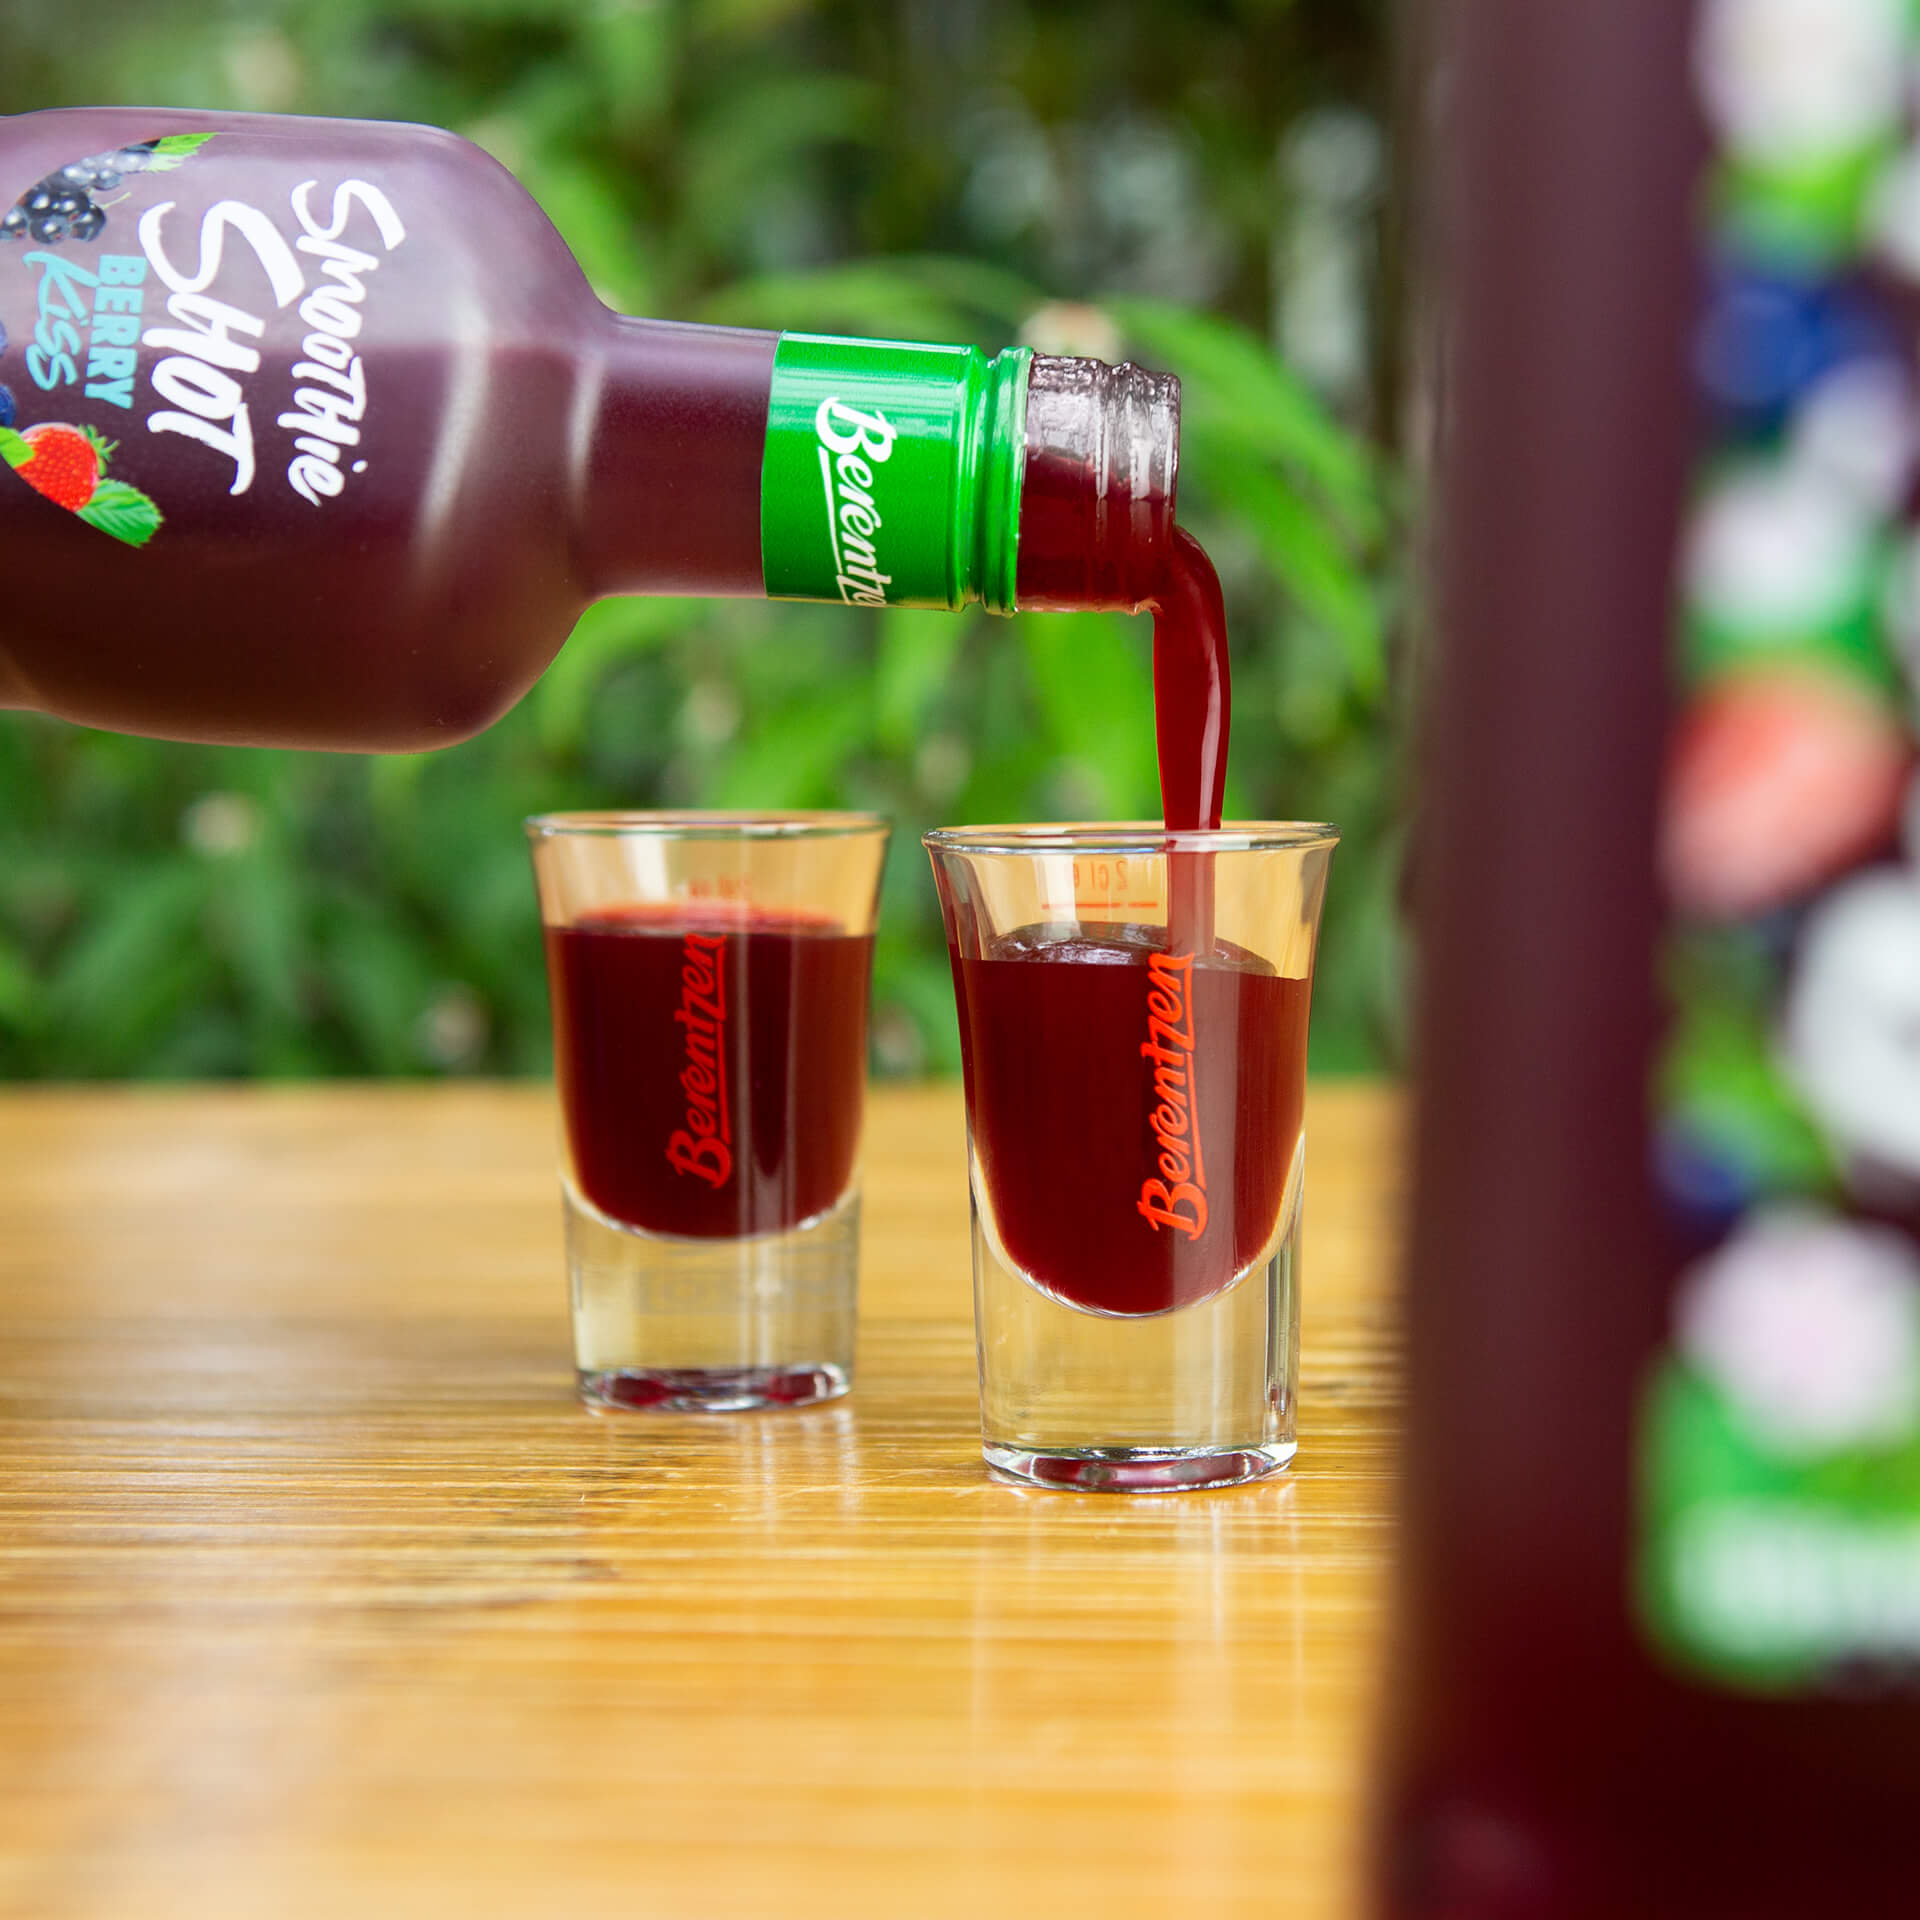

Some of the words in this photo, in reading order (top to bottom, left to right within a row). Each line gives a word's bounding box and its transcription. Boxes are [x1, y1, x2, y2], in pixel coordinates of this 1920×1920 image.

[85, 254, 147, 409] BERRY
[138, 200, 305, 495] SHOT
[815, 396, 898, 607] Berentze
[666, 933, 731, 1188] Berentzen
[1137, 952, 1208, 1240] Berentzen
